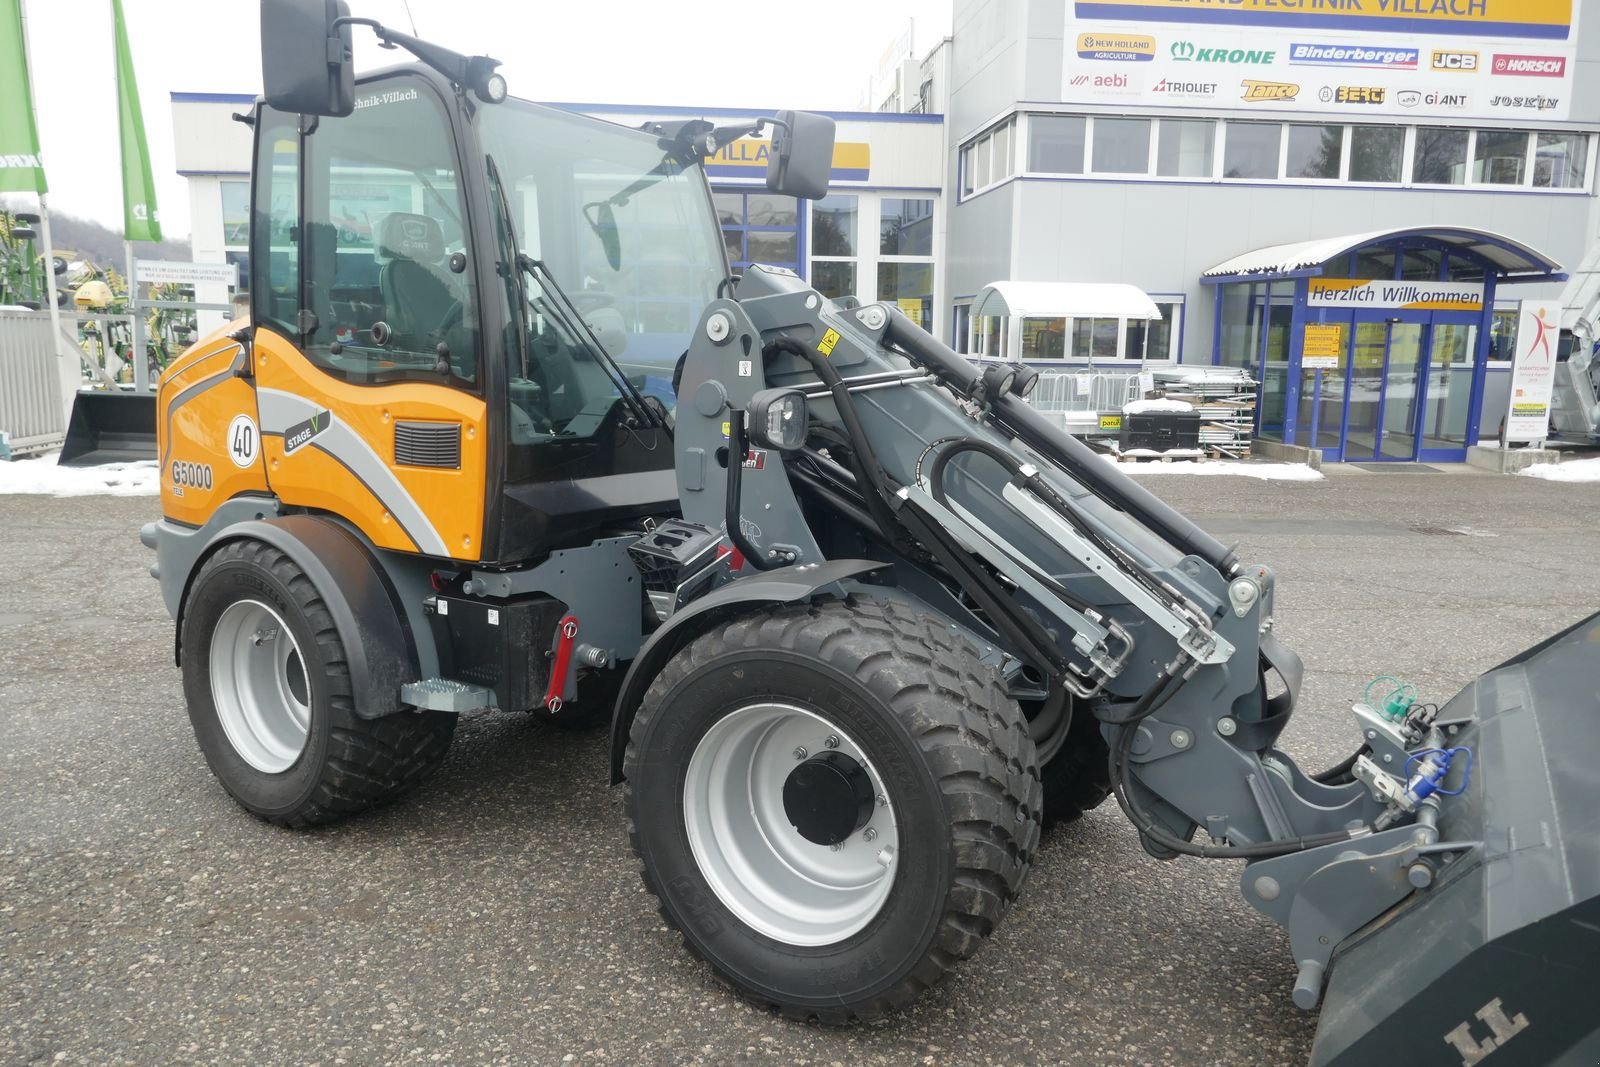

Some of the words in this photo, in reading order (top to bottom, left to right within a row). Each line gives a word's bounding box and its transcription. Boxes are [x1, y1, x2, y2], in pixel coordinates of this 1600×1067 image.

[1376, 0, 1487, 17] VILLACH
[1115, 41, 1150, 49] HOLLAND
[1094, 52, 1137, 60] AGRICULTURE
[1195, 48, 1276, 64] KRONE
[1293, 46, 1416, 63] Binderberger
[1433, 54, 1476, 69] JCB
[1506, 59, 1562, 73] HORSCH
[1094, 74, 1128, 87] aebi
[1167, 82, 1218, 94] TRIOLIET
[1240, 79, 1300, 101] Tanco
[1490, 95, 1558, 110] JOSKIN
[1312, 285, 1375, 301] Herzlich
[1382, 287, 1480, 304] Willkommen
[233, 425, 252, 458] 40
[287, 428, 312, 449] STAGE
[172, 461, 213, 490] G5000
